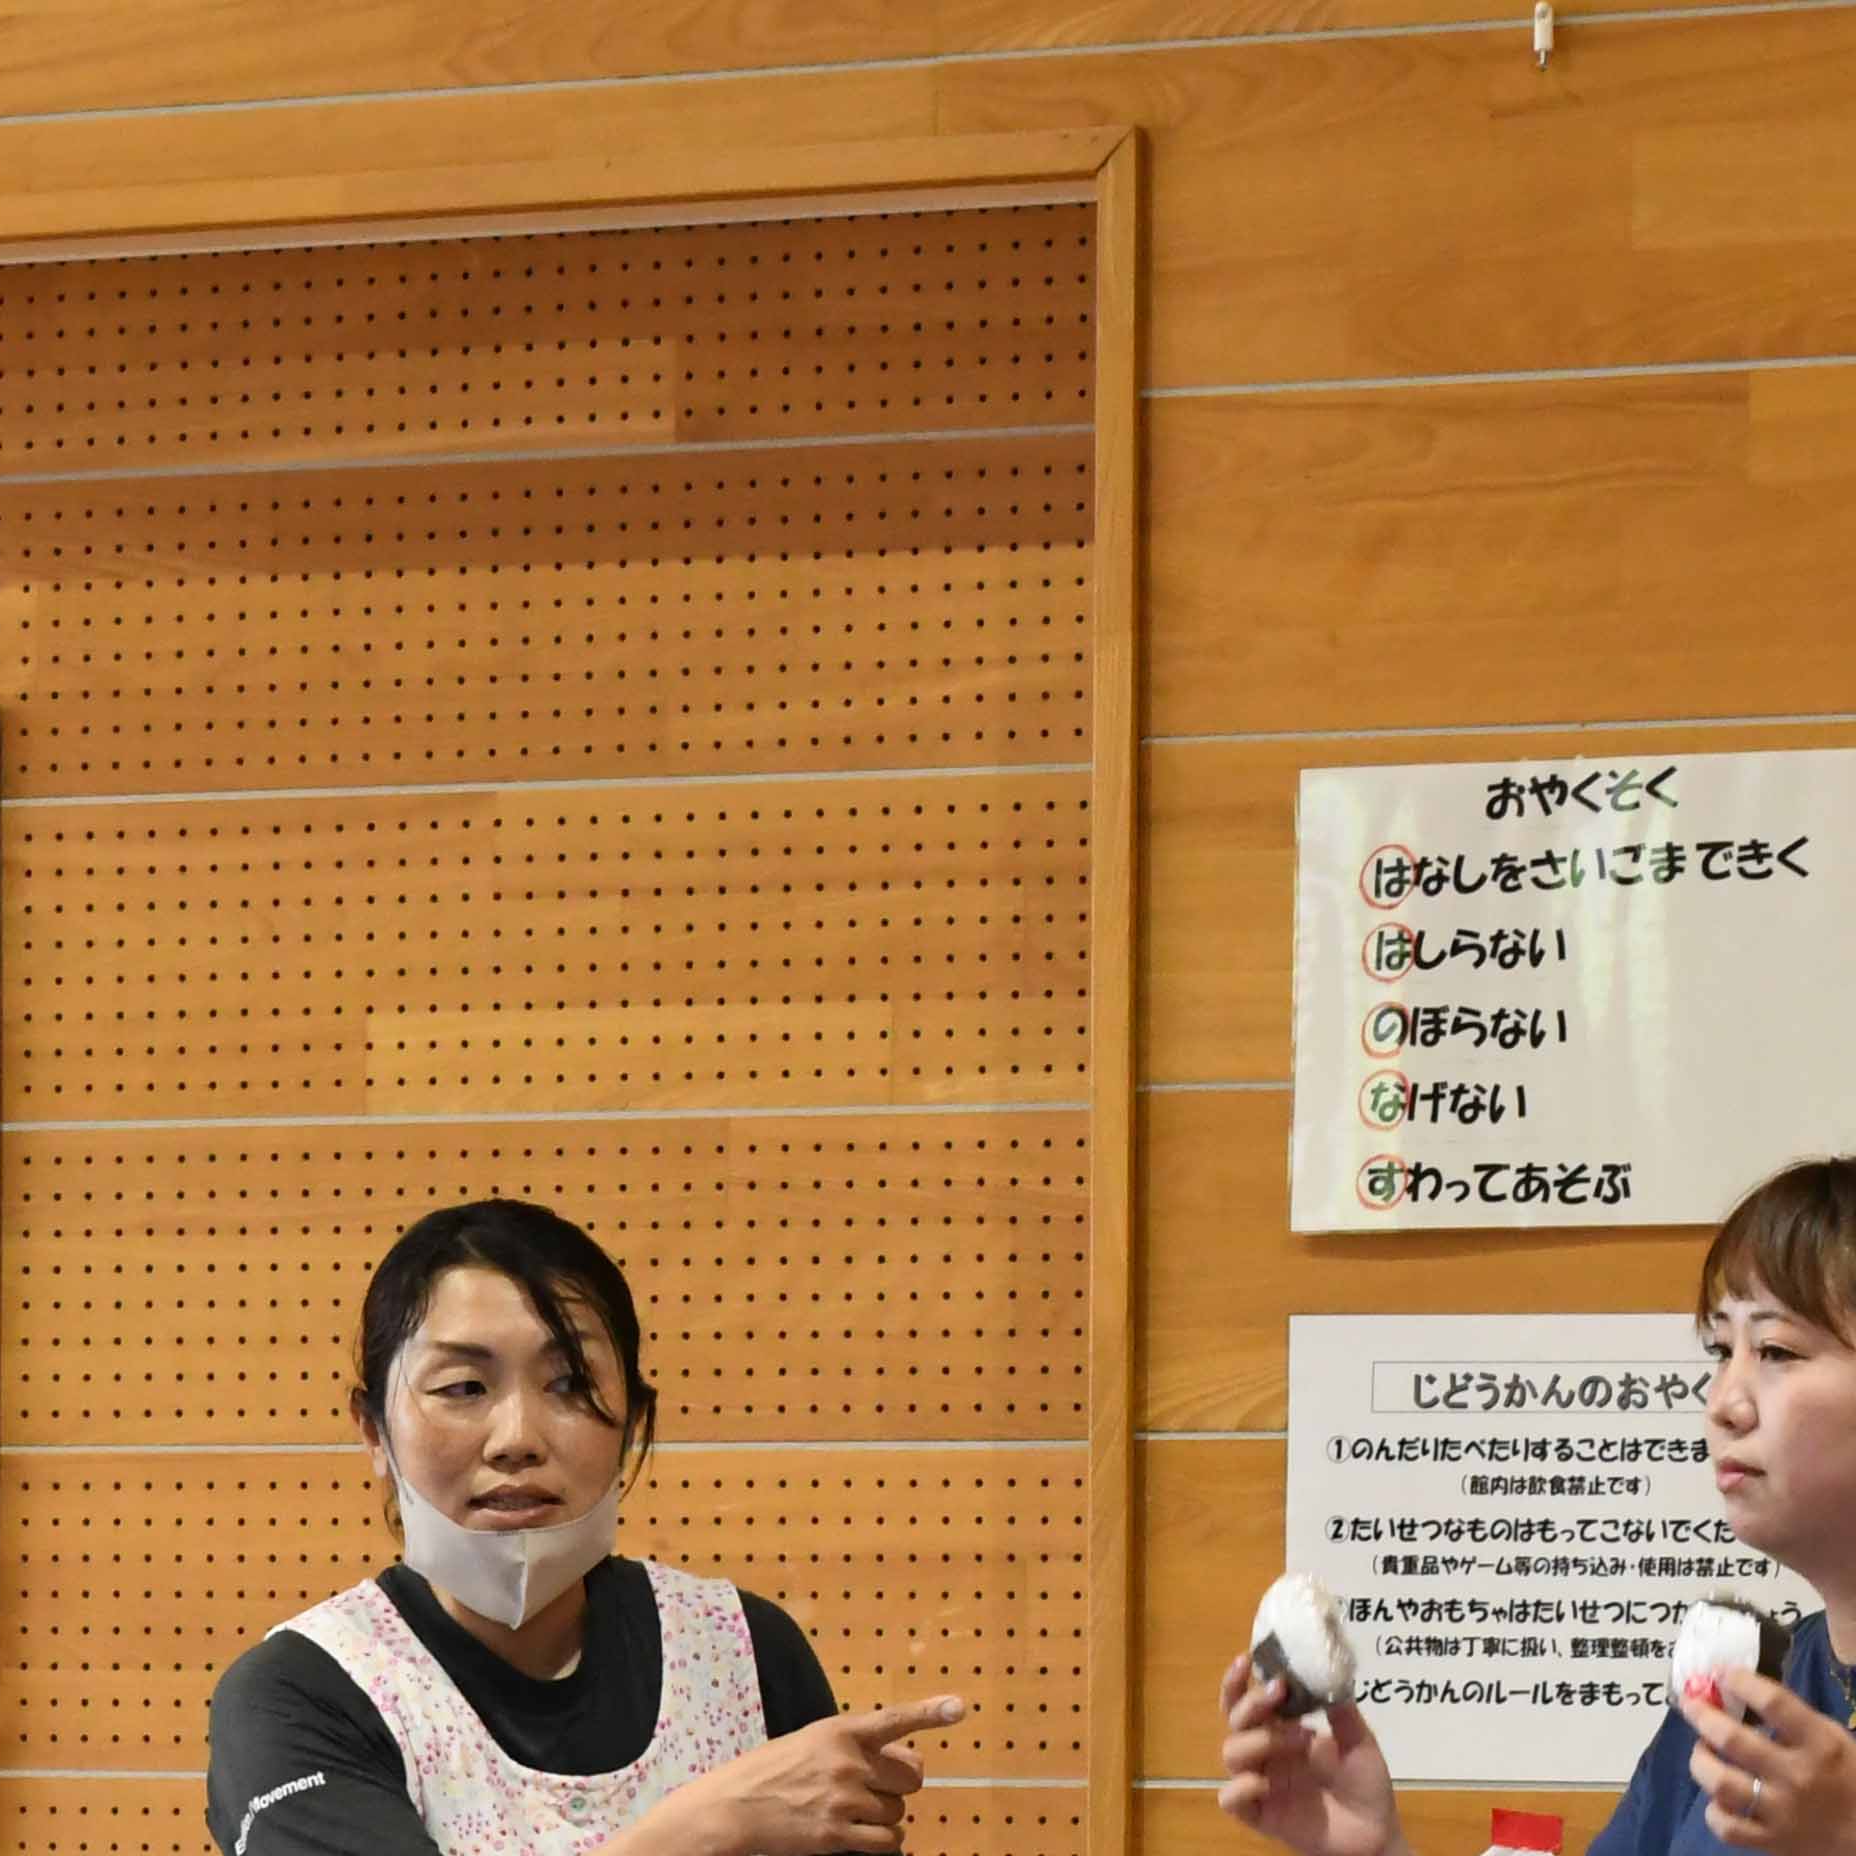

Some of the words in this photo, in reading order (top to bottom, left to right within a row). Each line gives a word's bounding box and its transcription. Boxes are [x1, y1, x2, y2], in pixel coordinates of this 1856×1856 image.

[1485, 765, 1679, 821] おやくそく
[1373, 835, 1810, 900] はなしをさいごまできく
[1375, 926, 1567, 972] はしらない
[1371, 1004, 1568, 1050] のぼらない
[1369, 1080, 1527, 1125] なげない
[1366, 1160, 1633, 1206] すわってあそぶ
[1412, 1371, 1714, 1411] じどうかんのおやく
[1460, 1473, 1652, 1498] （館内は飲食禁止です）
[1353, 1678, 1671, 1706] じどうかんのルールをまもって
